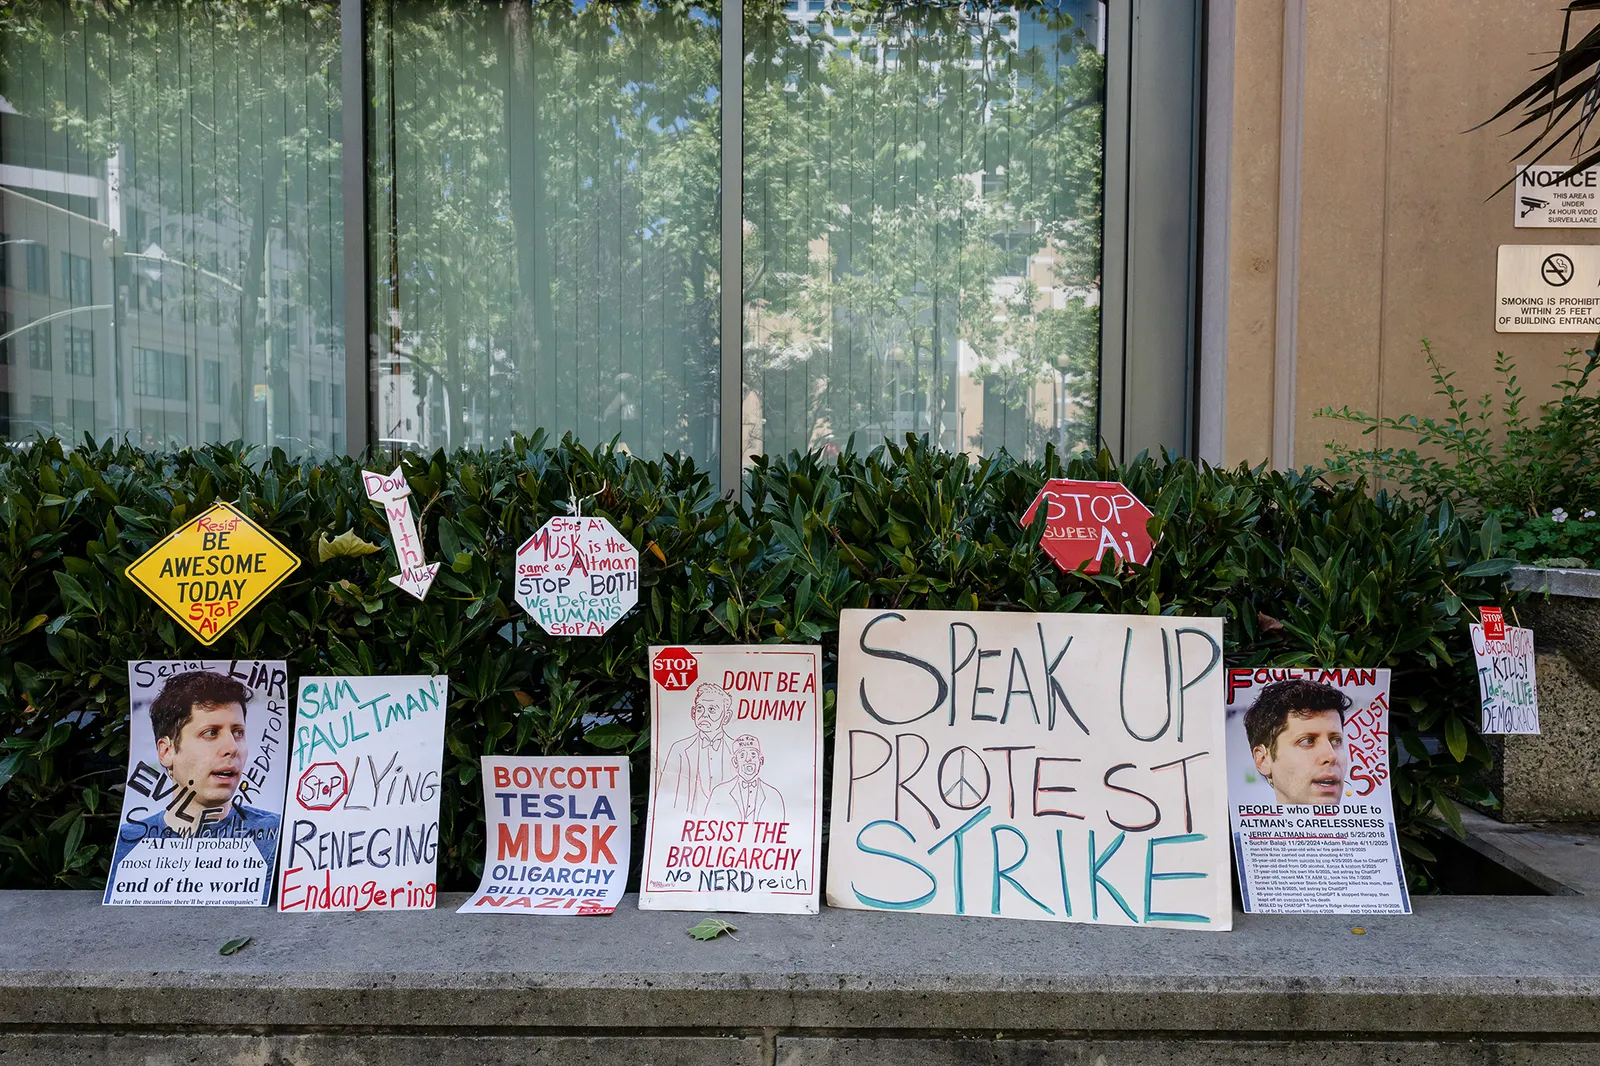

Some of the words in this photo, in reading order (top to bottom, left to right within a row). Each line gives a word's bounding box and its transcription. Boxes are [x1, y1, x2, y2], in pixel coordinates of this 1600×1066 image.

[1522, 171, 1597, 187] NOTICE
[1501, 297, 1544, 305] SMOKING
[1547, 297, 1556, 305] IS
[1521, 307, 1552, 315] WITHIN
[1555, 307, 1566, 315] 25
[1570, 307, 1592, 315] FEET
[1499, 317, 1511, 325] OF
[1514, 317, 1556, 325] BUILDING
[364, 475, 409, 496] Dow
[1042, 491, 1135, 525] STOP
[197, 517, 242, 532] Resist
[587, 519, 605, 532] Ai
[1043, 525, 1099, 539] SUPER
[202, 531, 231, 551] BE
[518, 527, 585, 562] MUSK
[588, 540, 601, 553] is
[605, 537, 632, 553] the
[1095, 525, 1136, 563] Ai
[159, 553, 267, 578] AWESOME
[518, 563, 550, 575] same
[555, 563, 567, 571] as
[566, 551, 637, 577] Altman
[177, 579, 247, 603] TODAY
[518, 577, 571, 595] STOP
[590, 571, 637, 596] BOTH
[525, 595, 550, 609] We
[556, 588, 622, 610] Defend
[198, 618, 218, 634] Ai
[539, 606, 622, 625] HUMANS
[1483, 613, 1501, 622] STOP
[1493, 622, 1502, 632] AI
[586, 621, 605, 635] Ai
[653, 658, 697, 671] STOP
[664, 672, 689, 688] AI
[723, 670, 774, 692] DONT
[776, 672, 801, 693] BE
[802, 672, 815, 694] A
[859, 612, 1091, 735] SPEAK
[1119, 627, 1222, 743] UP
[298, 679, 361, 719] SAM
[737, 699, 807, 722] DUMMY
[1343, 692, 1389, 741] JUST
[1482, 701, 1539, 733] DEMOCRACY
[1348, 722, 1389, 762] ASK
[232, 700, 286, 820] PREDATOR
[1356, 745, 1387, 769] his
[493, 766, 620, 789] BOYCOTT
[846, 729, 1210, 834] PROTEST
[1350, 763, 1388, 797] Sis
[495, 793, 616, 821] TESLA
[1238, 805, 1284, 814] PEOPLE
[1287, 805, 1310, 814] who
[1313, 805, 1340, 814] DIED
[1343, 805, 1368, 814] DUE
[1370, 805, 1382, 814] to
[680, 820, 749, 843] RESIST
[753, 822, 790, 844] THE
[1240, 818, 1293, 828] ALTMAN's
[1296, 818, 1385, 828] CARELESSNESS
[169, 838, 193, 850] will
[196, 838, 252, 853] probably
[288, 819, 438, 871] RENEGING
[497, 823, 618, 865] MUSK
[121, 858, 152, 869] most
[155, 857, 192, 872] likely
[194, 857, 222, 869] lead
[226, 858, 240, 869] to
[243, 857, 264, 869] the
[666, 846, 802, 871] BROLIGARCHY
[851, 805, 1212, 923] STRIKE
[116, 877, 149, 893] end
[153, 877, 174, 893] of
[177, 877, 204, 893] the
[210, 877, 260, 893] world
[492, 864, 615, 885] OLIGARCHY
[698, 869, 755, 893] NERD
[758, 870, 807, 891] reich
[281, 867, 437, 912] Endangering
[486, 885, 609, 898] BILLIONAIRE
[474, 896, 606, 909] NAZIS
